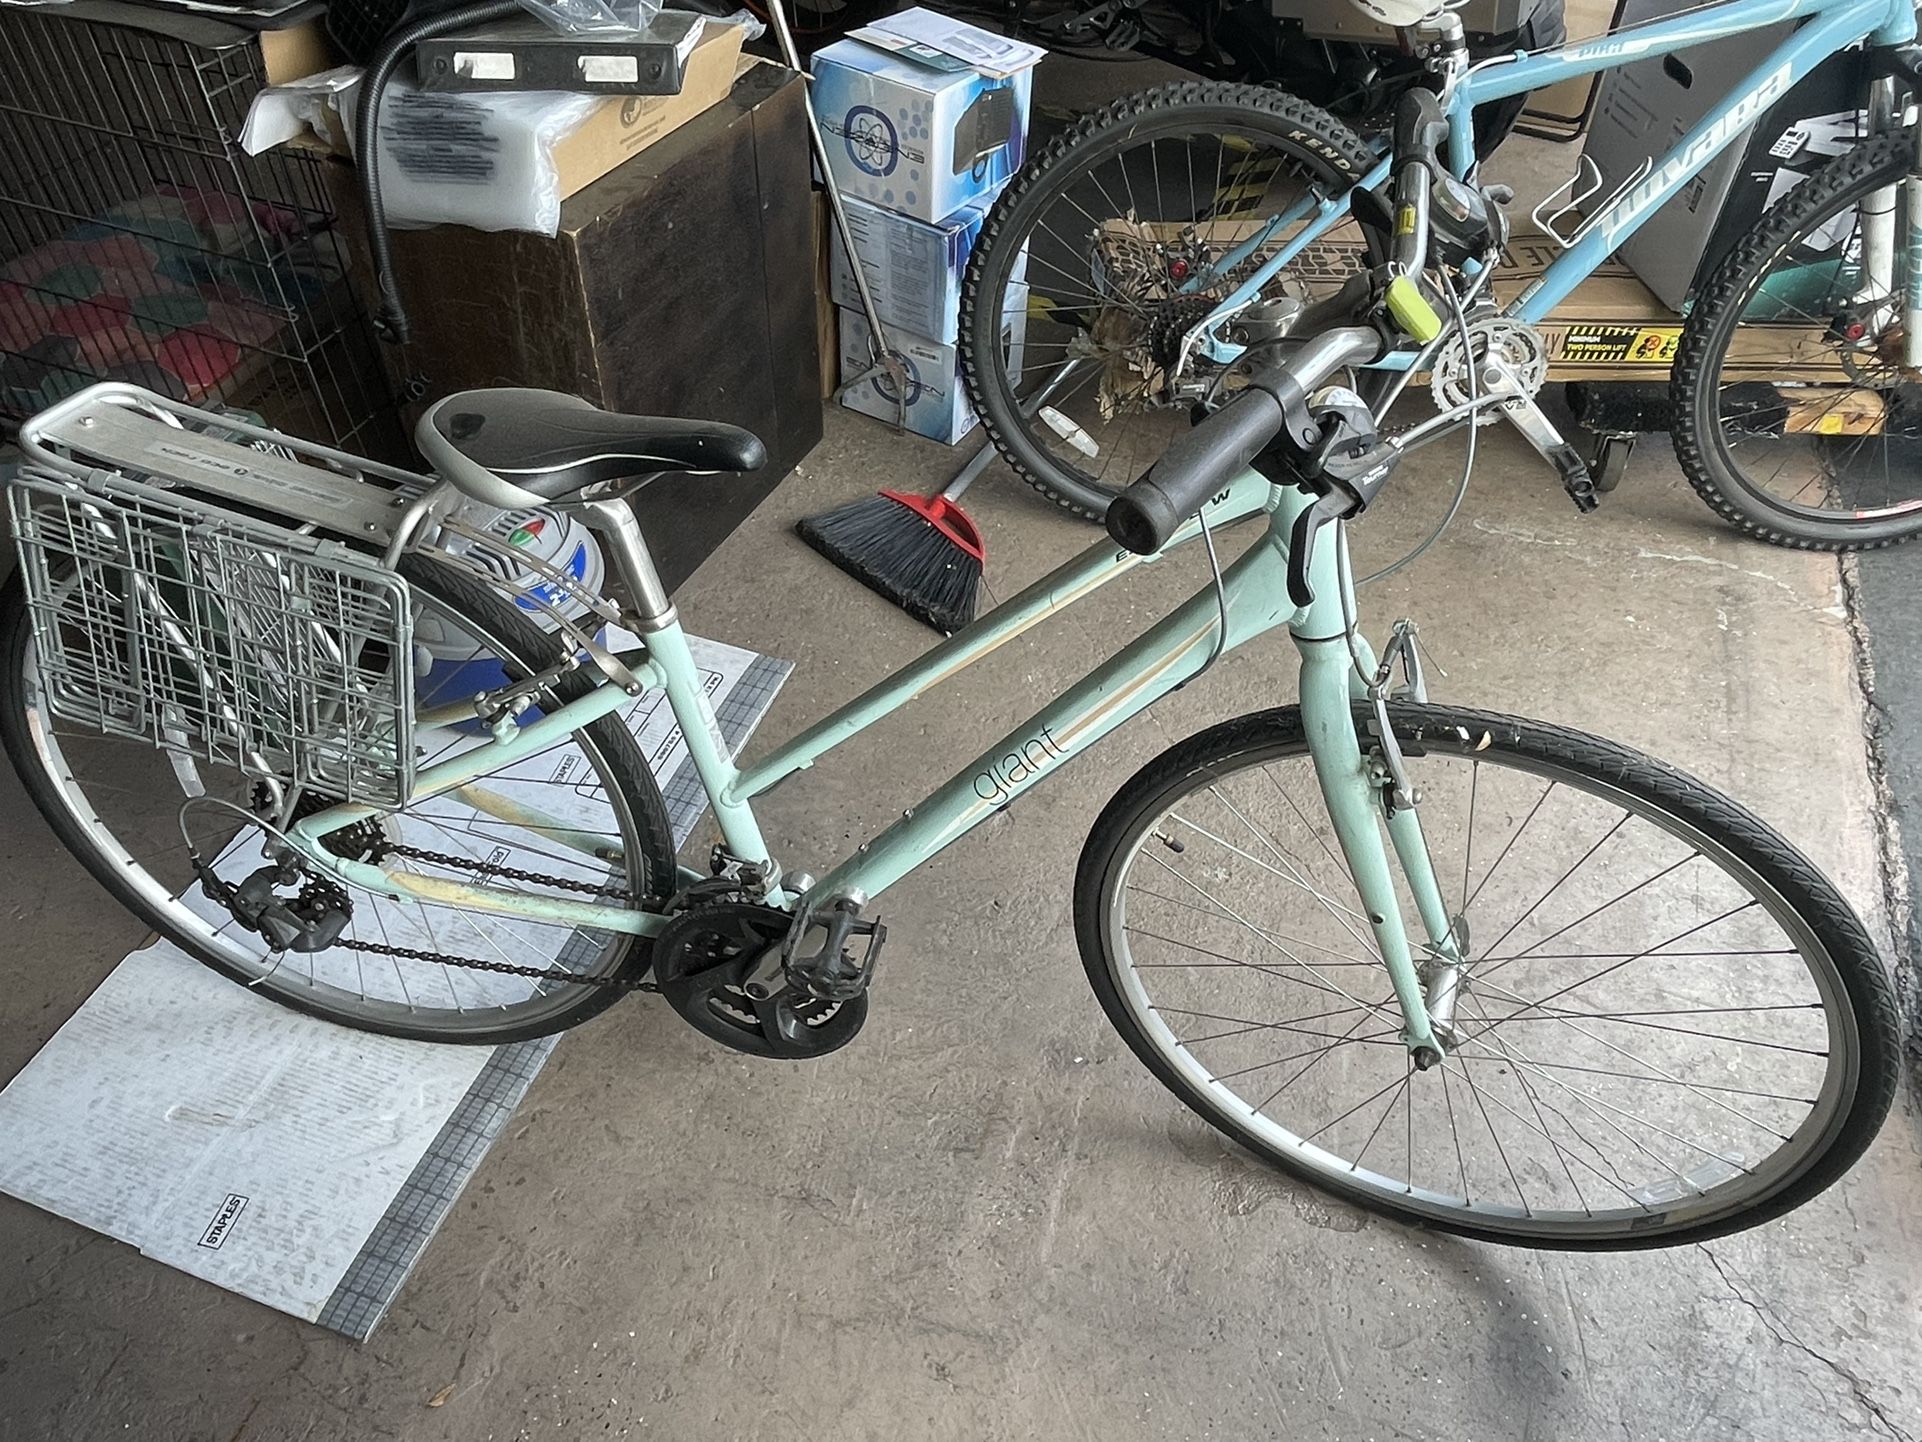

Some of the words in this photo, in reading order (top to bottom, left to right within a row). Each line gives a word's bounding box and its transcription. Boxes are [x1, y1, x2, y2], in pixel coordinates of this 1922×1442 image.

[1566, 343, 1584, 351] TWO
[1584, 343, 1612, 351] PERSON
[973, 723, 1070, 806] giant
[206, 1196, 241, 1244] STAPLES
